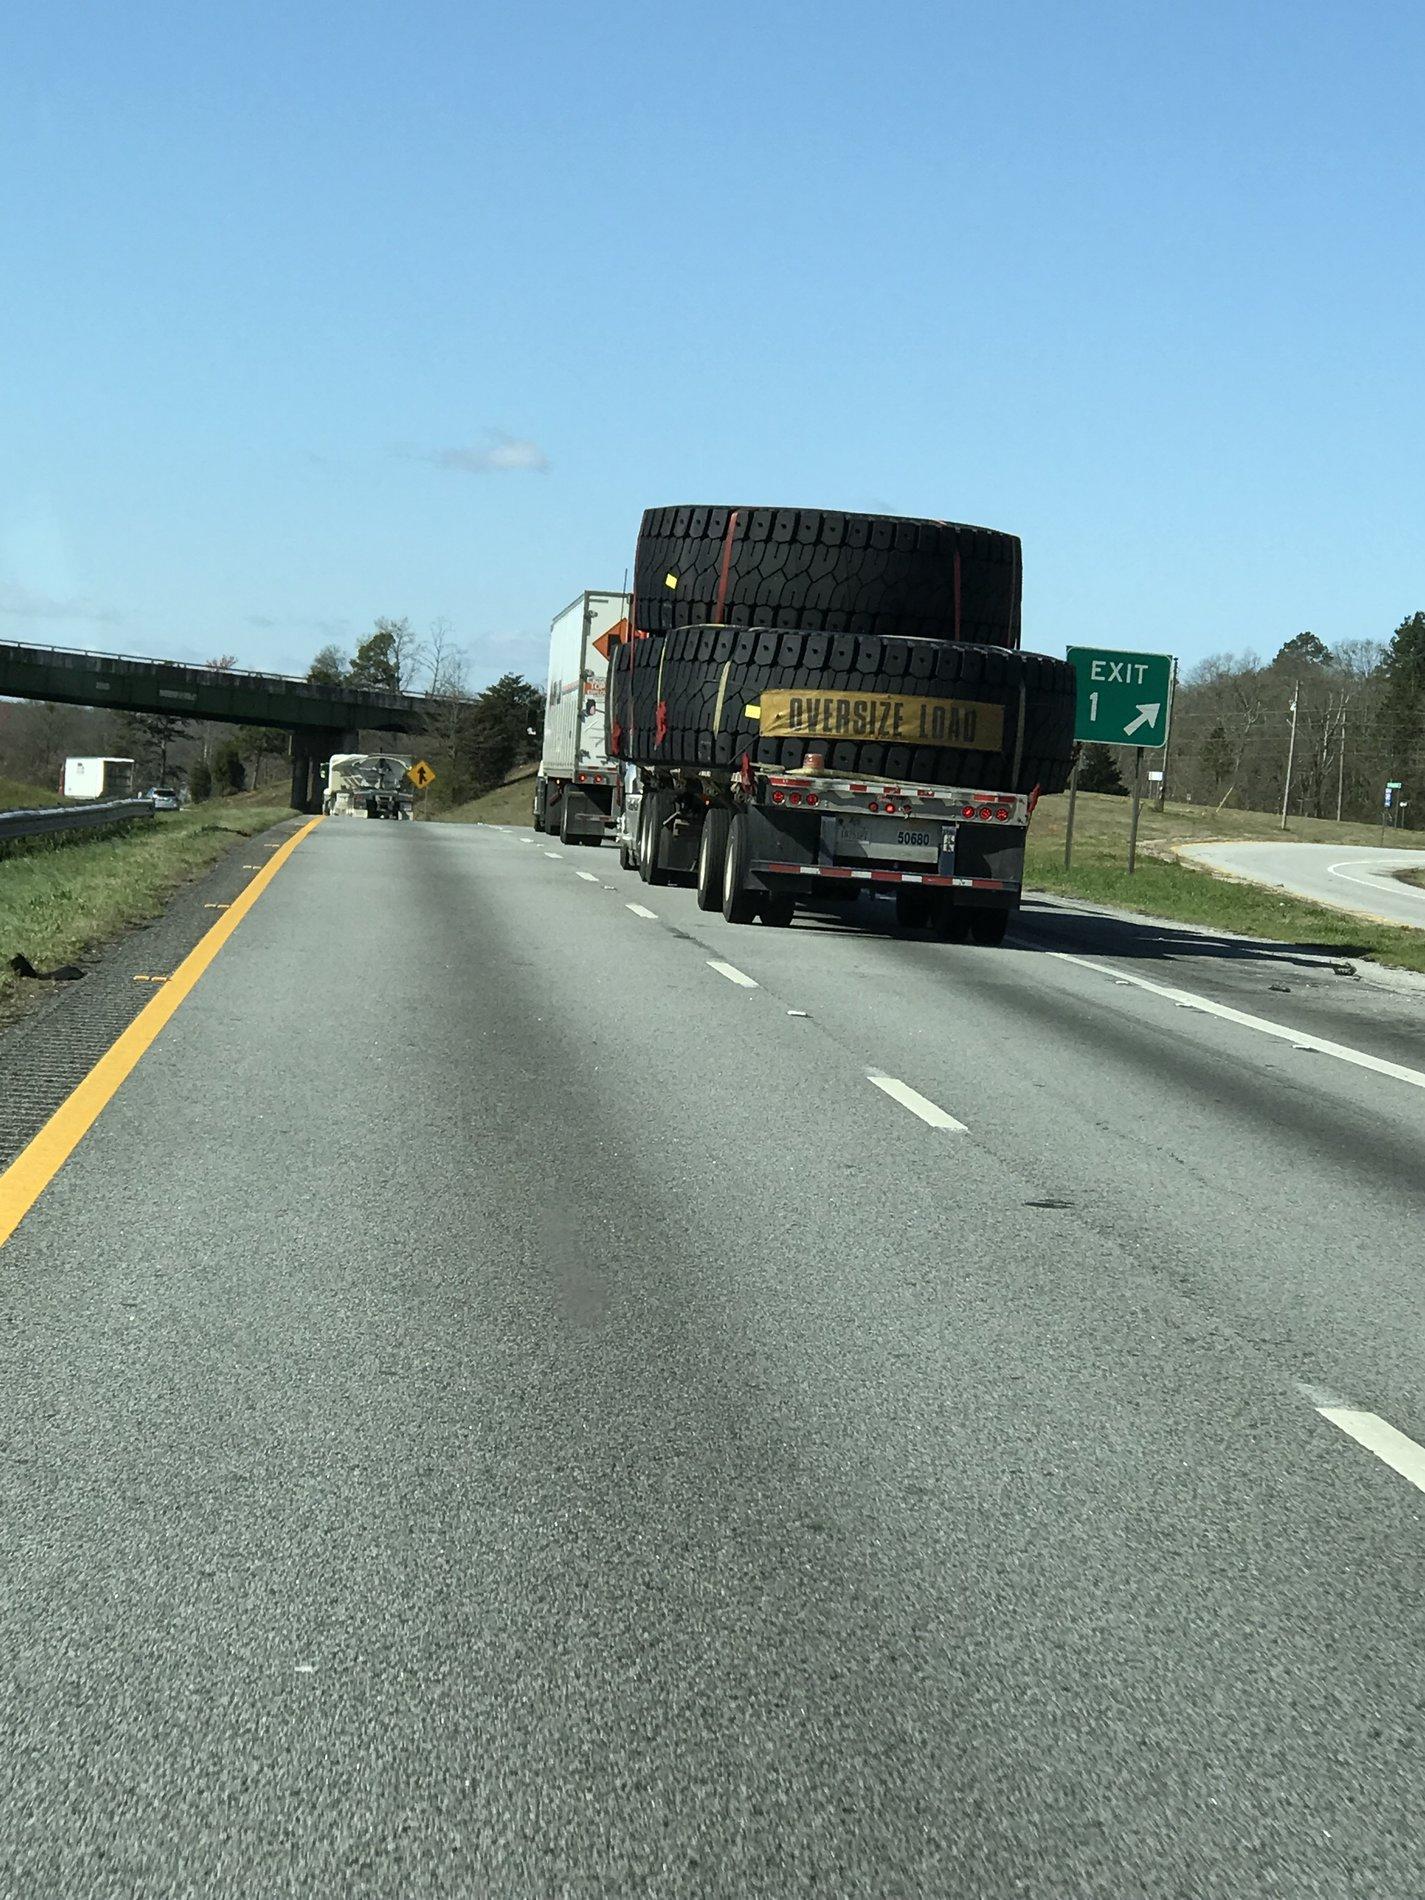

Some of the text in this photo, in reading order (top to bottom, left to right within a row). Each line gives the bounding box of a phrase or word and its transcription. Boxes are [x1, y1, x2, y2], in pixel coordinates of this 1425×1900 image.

[1090, 660, 1149, 684] EXIT
[789, 697, 978, 743] OVERSIZE LOAD
[1089, 691, 1099, 722] 1
[897, 831, 930, 846] 50680
